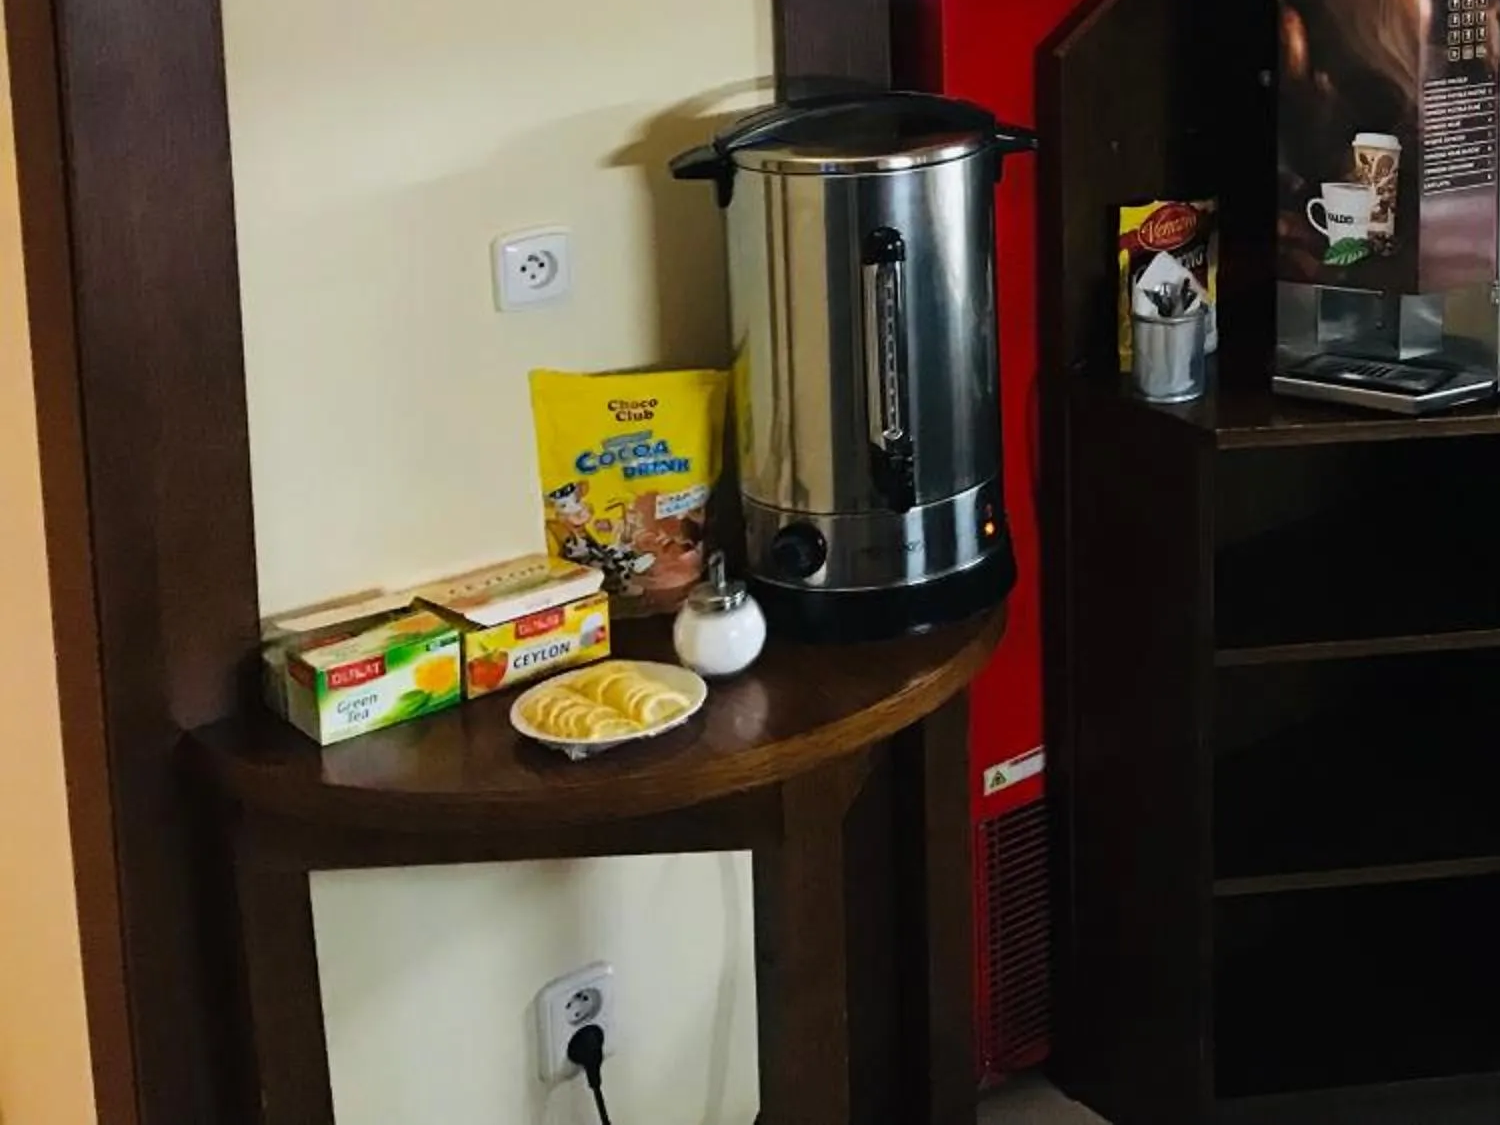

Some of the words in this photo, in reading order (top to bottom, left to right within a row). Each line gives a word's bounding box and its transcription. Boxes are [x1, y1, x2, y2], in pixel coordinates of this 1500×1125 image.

[608, 398, 657, 412] Choco
[615, 410, 654, 422] Club
[575, 439, 668, 474] COCOA
[622, 458, 690, 480] DRINK
[513, 641, 571, 669] CEYLON
[337, 693, 378, 714] Green
[347, 709, 369, 723] Tea
